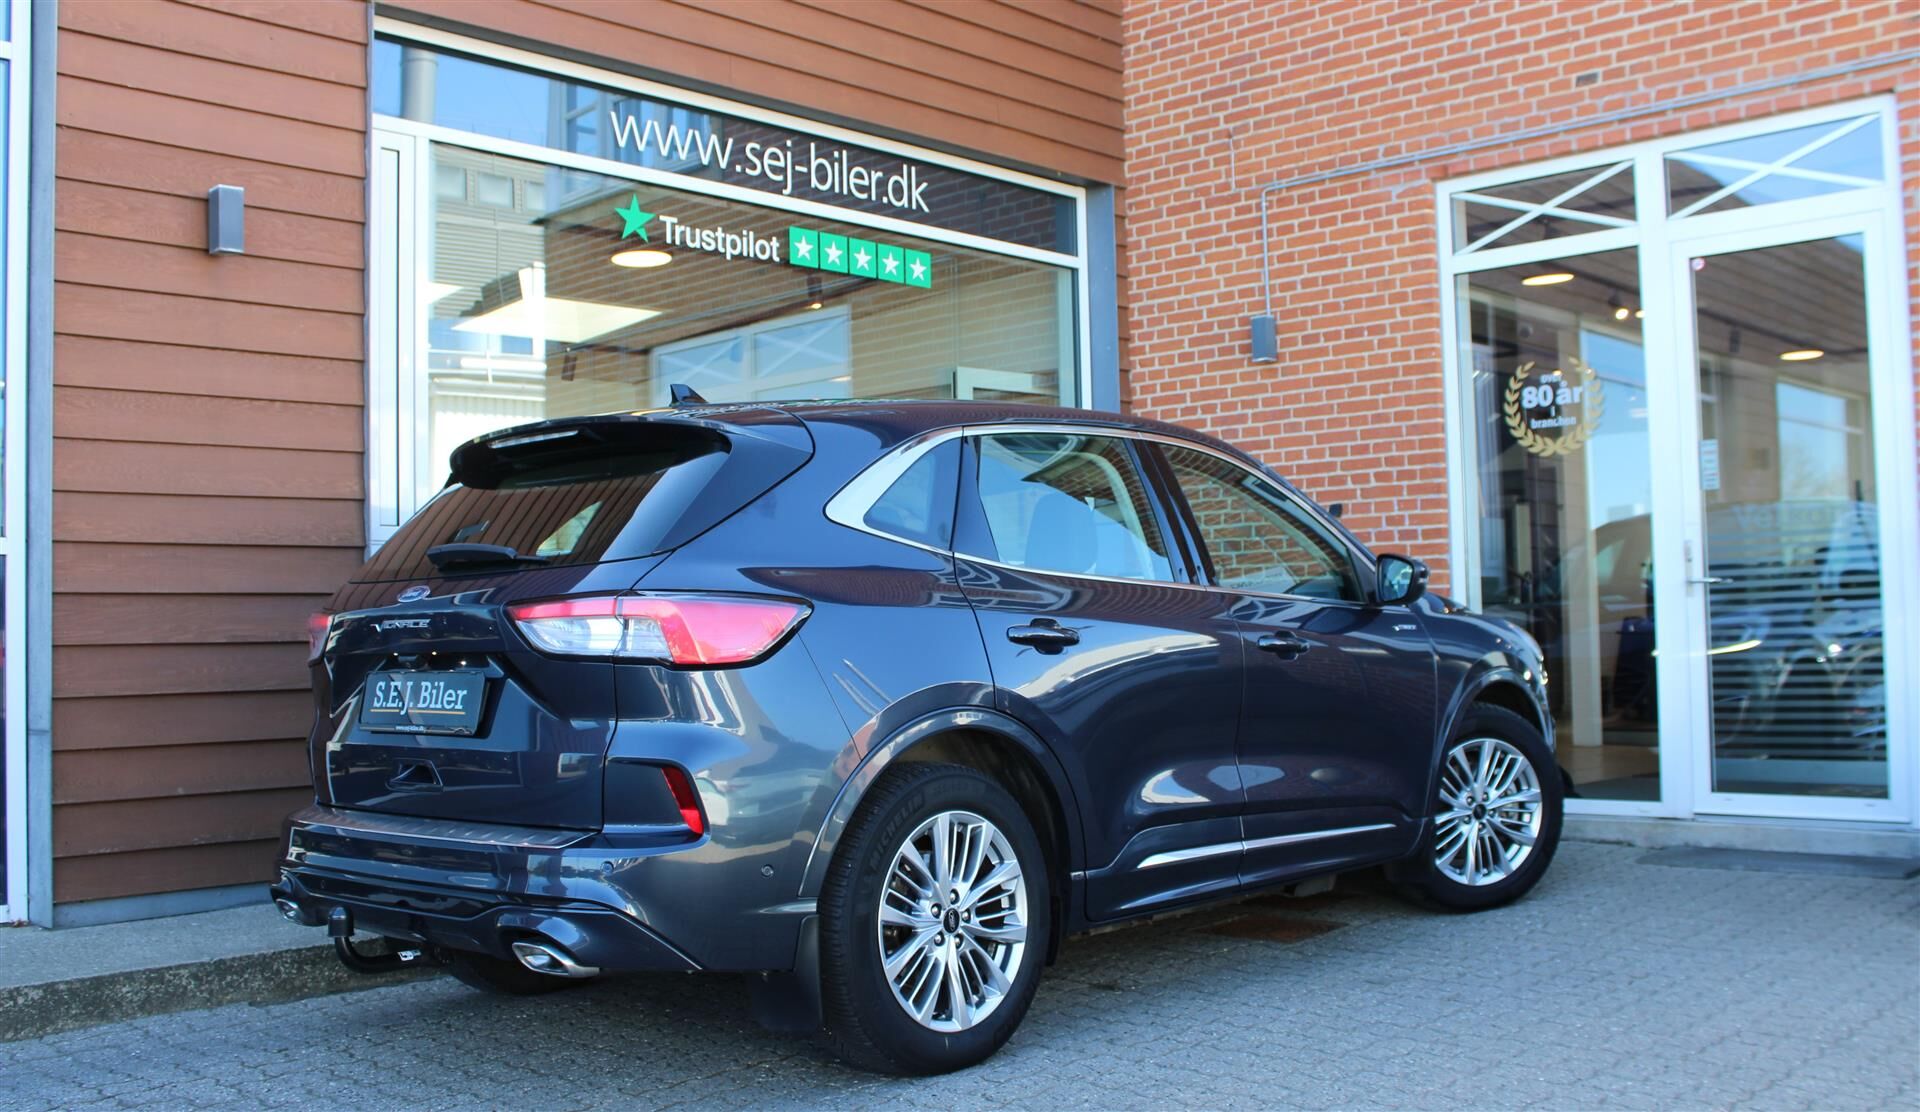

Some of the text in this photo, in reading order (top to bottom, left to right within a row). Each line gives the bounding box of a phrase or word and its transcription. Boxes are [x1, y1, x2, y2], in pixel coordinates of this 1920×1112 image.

[610, 111, 930, 213] www.sej-biler.dk
[659, 214, 780, 262] Trustpilot
[1521, 380, 1584, 409] 80 år
[1531, 417, 1576, 428] branchen
[1550, 406, 1555, 417] i
[373, 681, 467, 715] S.E.J. Biler
